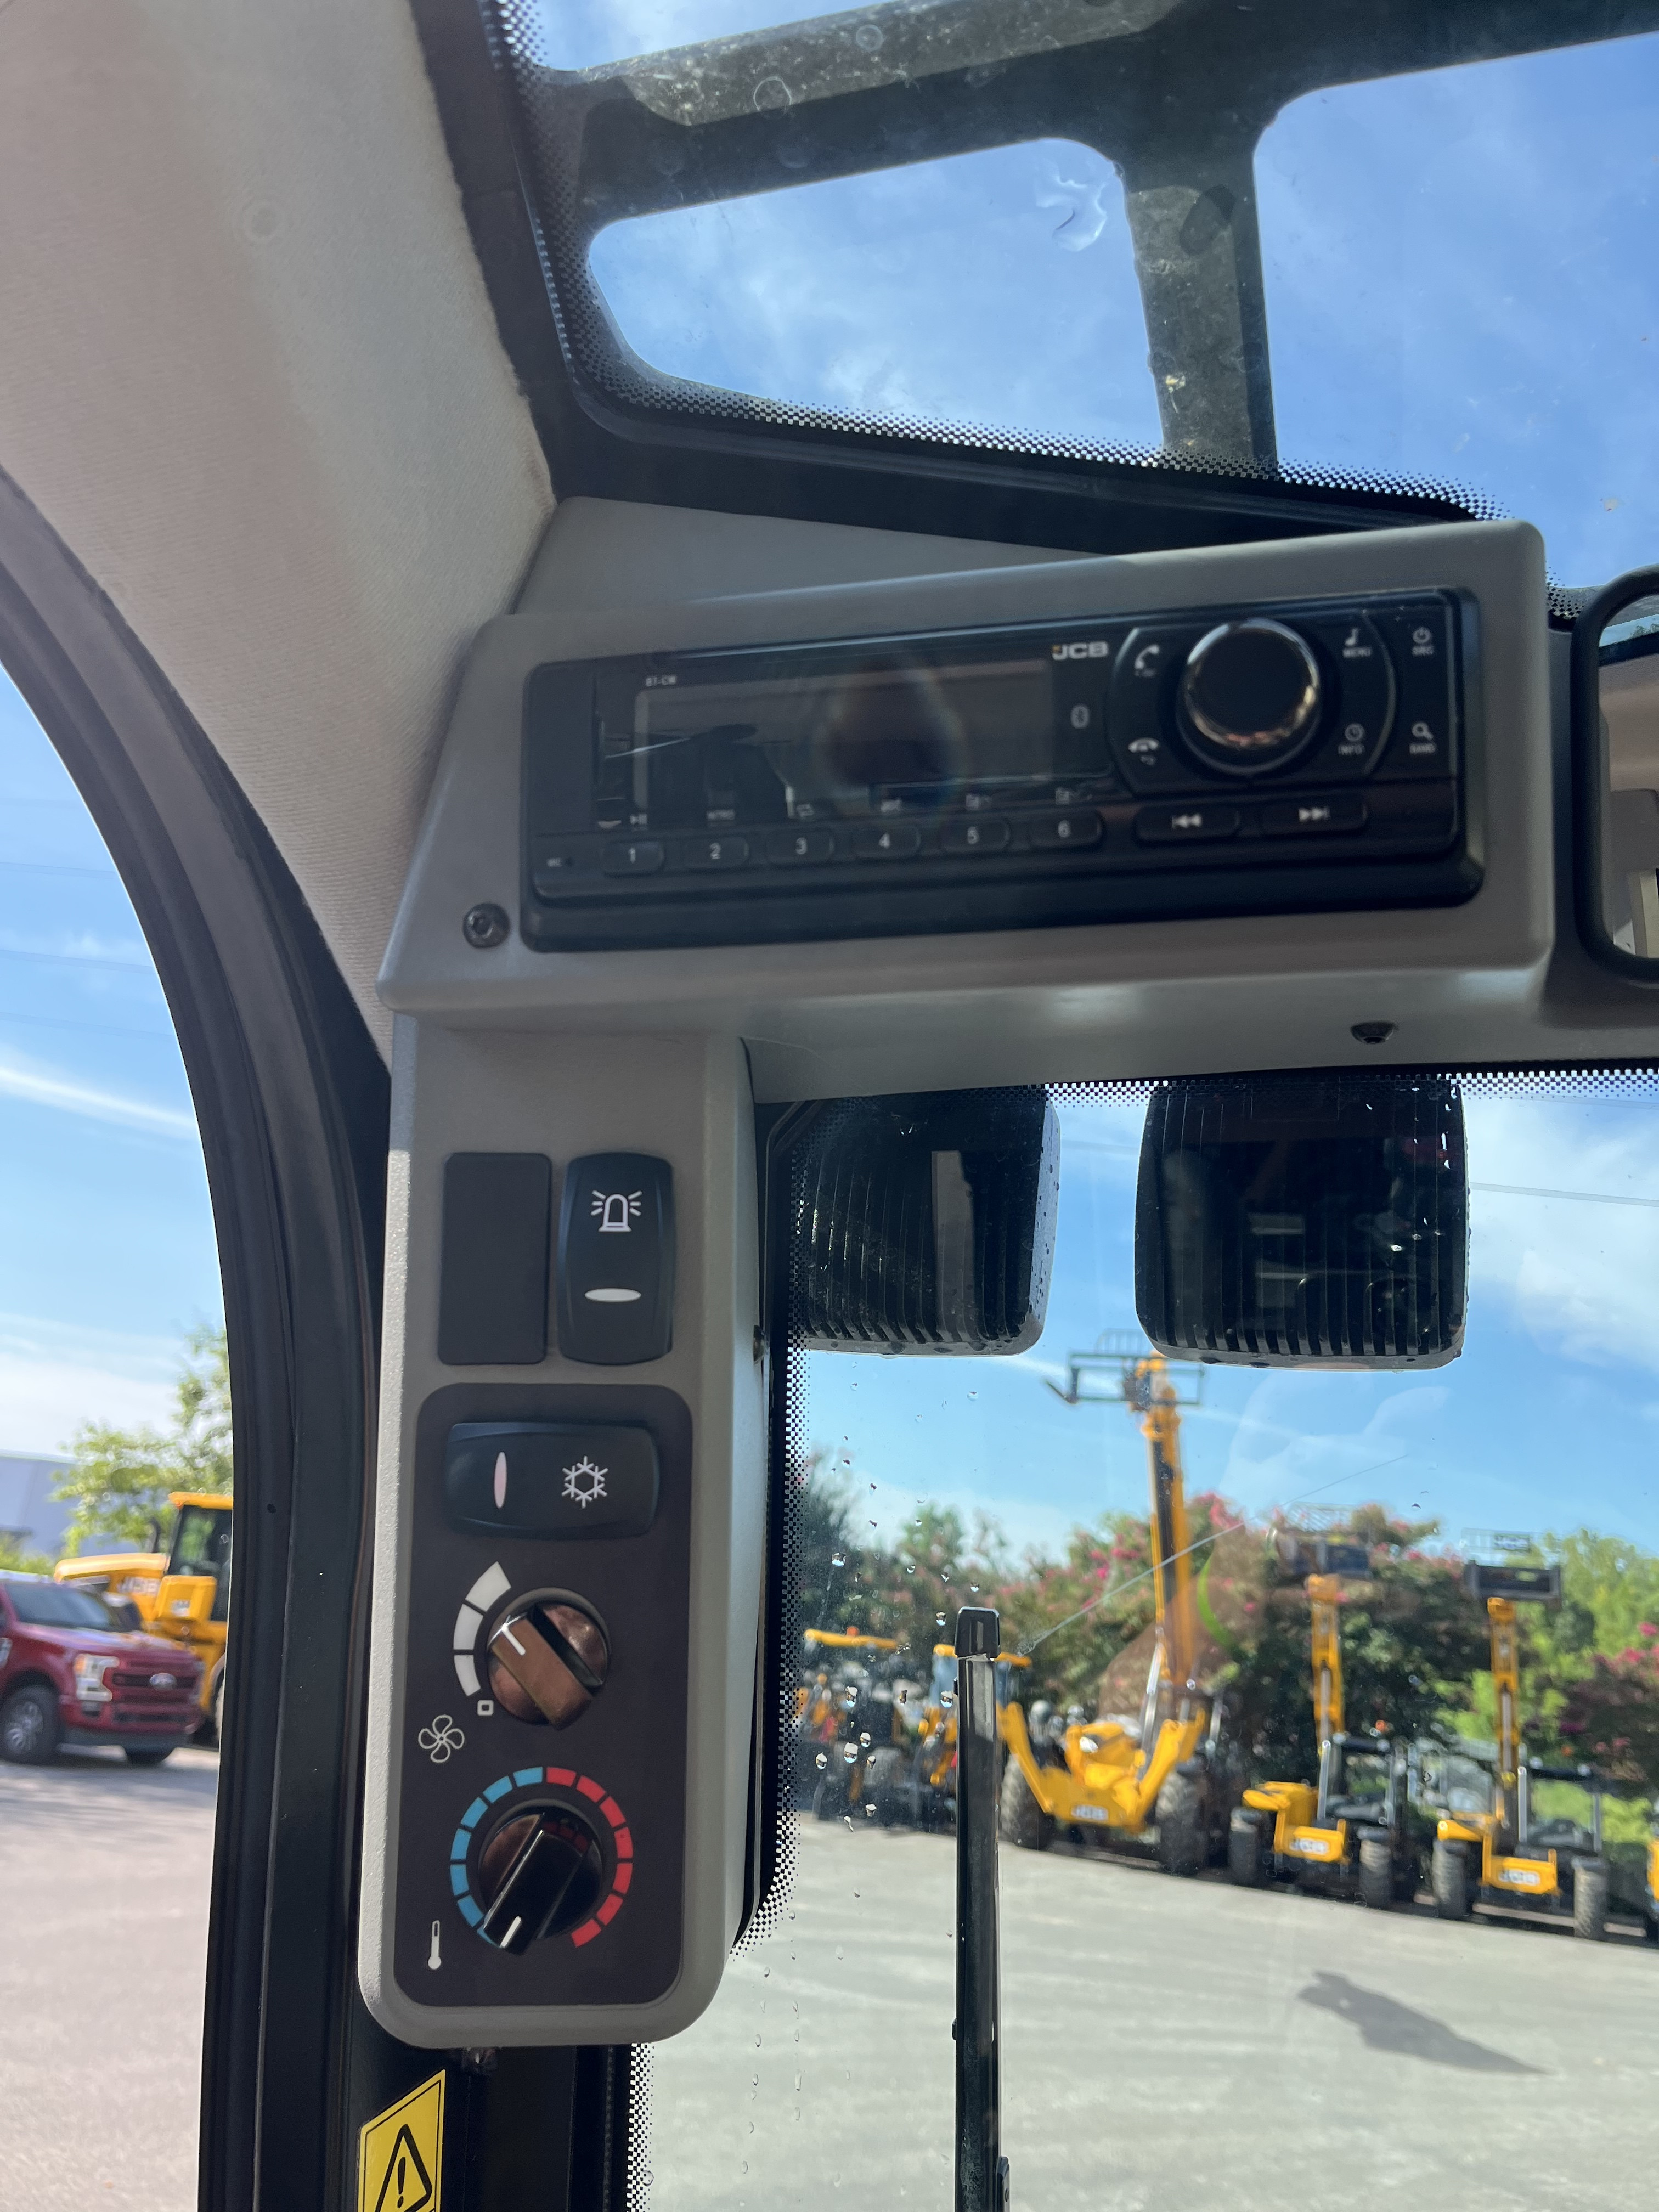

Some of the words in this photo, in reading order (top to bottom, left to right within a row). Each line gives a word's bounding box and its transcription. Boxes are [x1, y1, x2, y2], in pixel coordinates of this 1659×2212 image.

[1052, 641, 1109, 661] JCB
[967, 826, 979, 844] 5
[1058, 820, 1071, 838] 6
[796, 837, 808, 855] 3
[879, 833, 891, 848] 4
[628, 848, 636, 863] 1
[710, 843, 721, 859] 2
